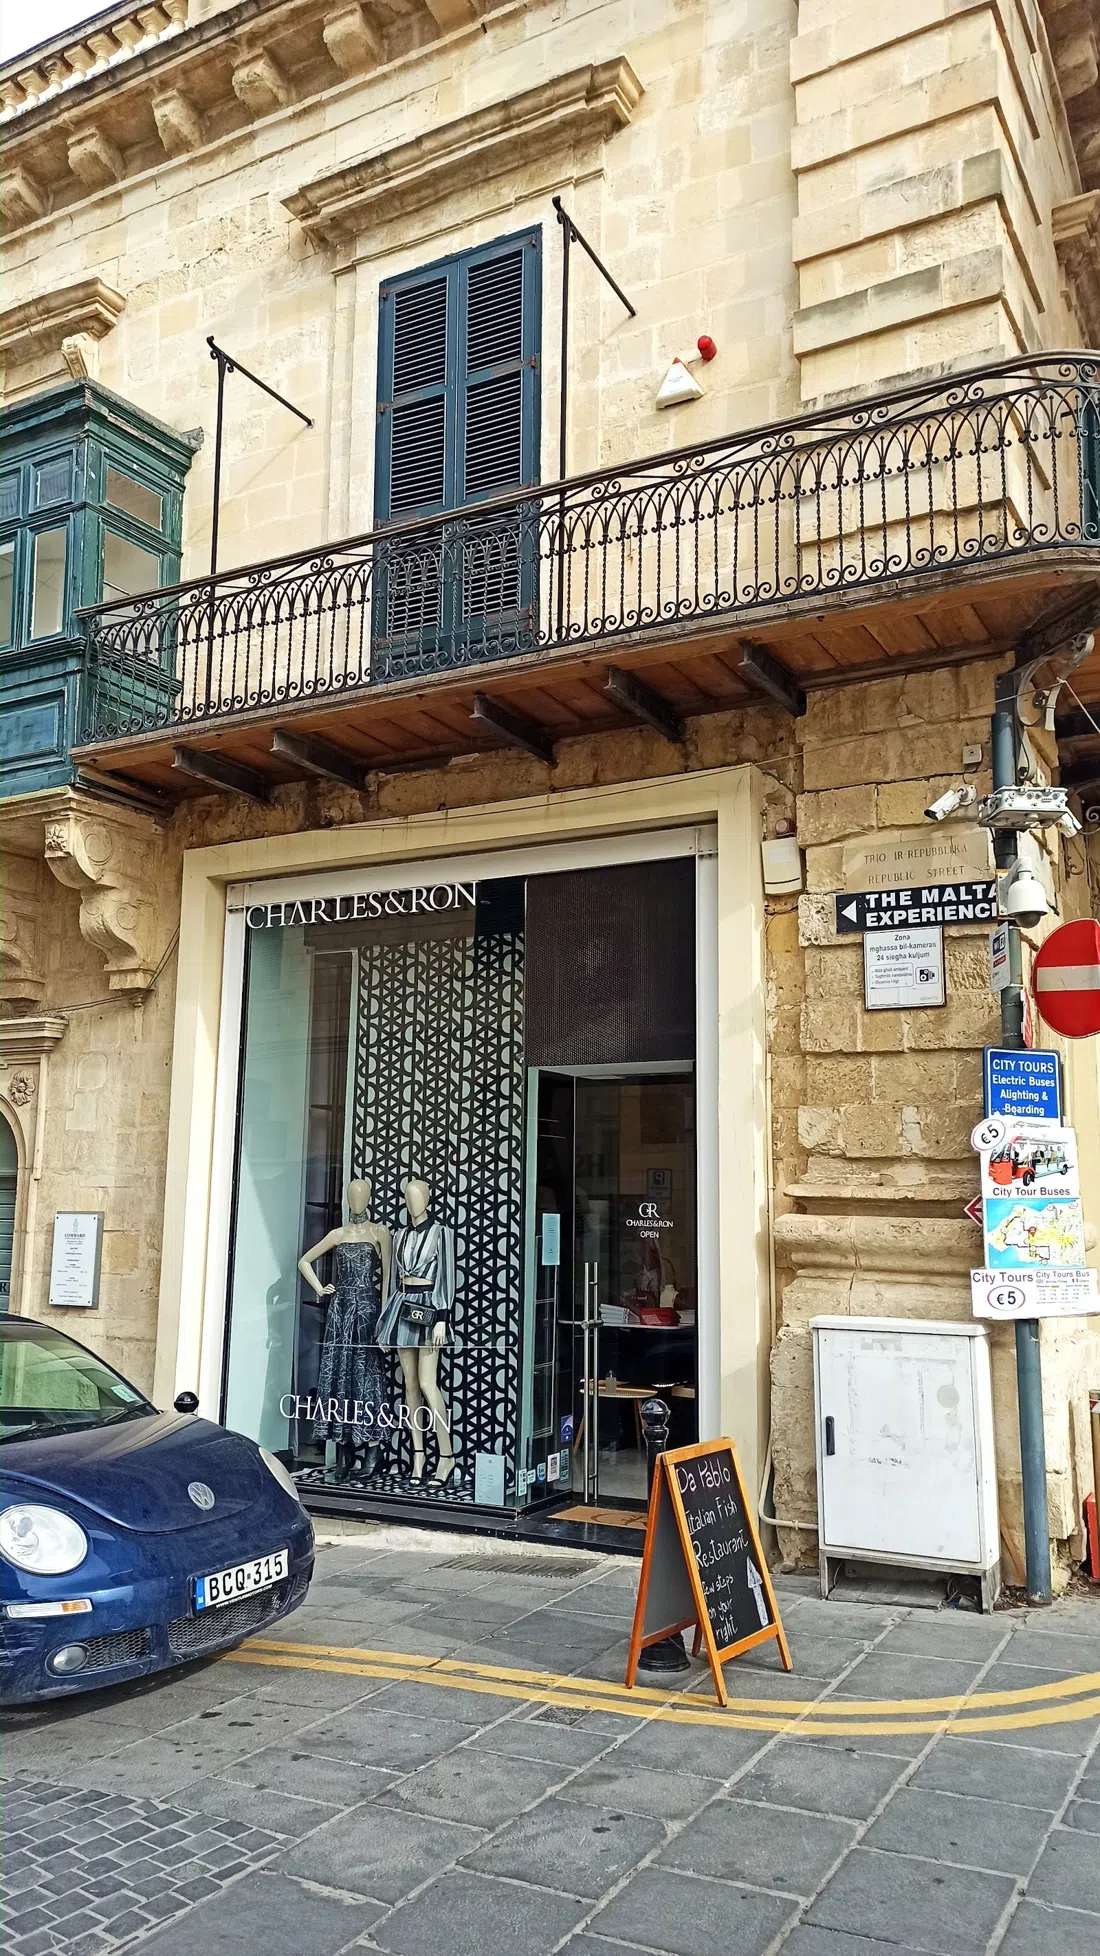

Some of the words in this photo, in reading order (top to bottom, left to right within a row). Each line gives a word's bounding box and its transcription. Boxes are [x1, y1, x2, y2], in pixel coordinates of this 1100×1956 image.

[868, 871, 915, 884] REPUBLIC
[926, 866, 965, 878] STREET
[866, 890, 912, 908] THE
[992, 1059, 1016, 1071] CITY
[1018, 1061, 1054, 1073] TOURS
[992, 1074, 1026, 1085] Electric
[1029, 1076, 1055, 1087] Buses
[1000, 1089, 1040, 1102] Alighting
[1041, 1091, 1048, 1100] &
[1004, 1103, 1045, 1116] Boarding
[992, 1187, 1012, 1197] City
[1015, 1187, 1037, 1196] Tour
[1040, 1187, 1070, 1196] Buses
[640, 1230, 659, 1238] OPEN
[972, 1272, 996, 1285] City
[999, 1272, 1034, 1283] Tours
[1036, 1271, 1051, 1279] City
[1075, 1270, 1090, 1278] Bus
[676, 1467, 697, 1494] Da
[698, 1458, 731, 1488] Pablo
[685, 1509, 717, 1535] Italian
[715, 1494, 738, 1520] Fish
[692, 1529, 749, 1570] Restaurant
[702, 1581, 715, 1604] few
[716, 1574, 734, 1595] steps
[709, 1607, 717, 1619] on
[718, 1599, 733, 1621] your
[716, 1614, 738, 1642] right
